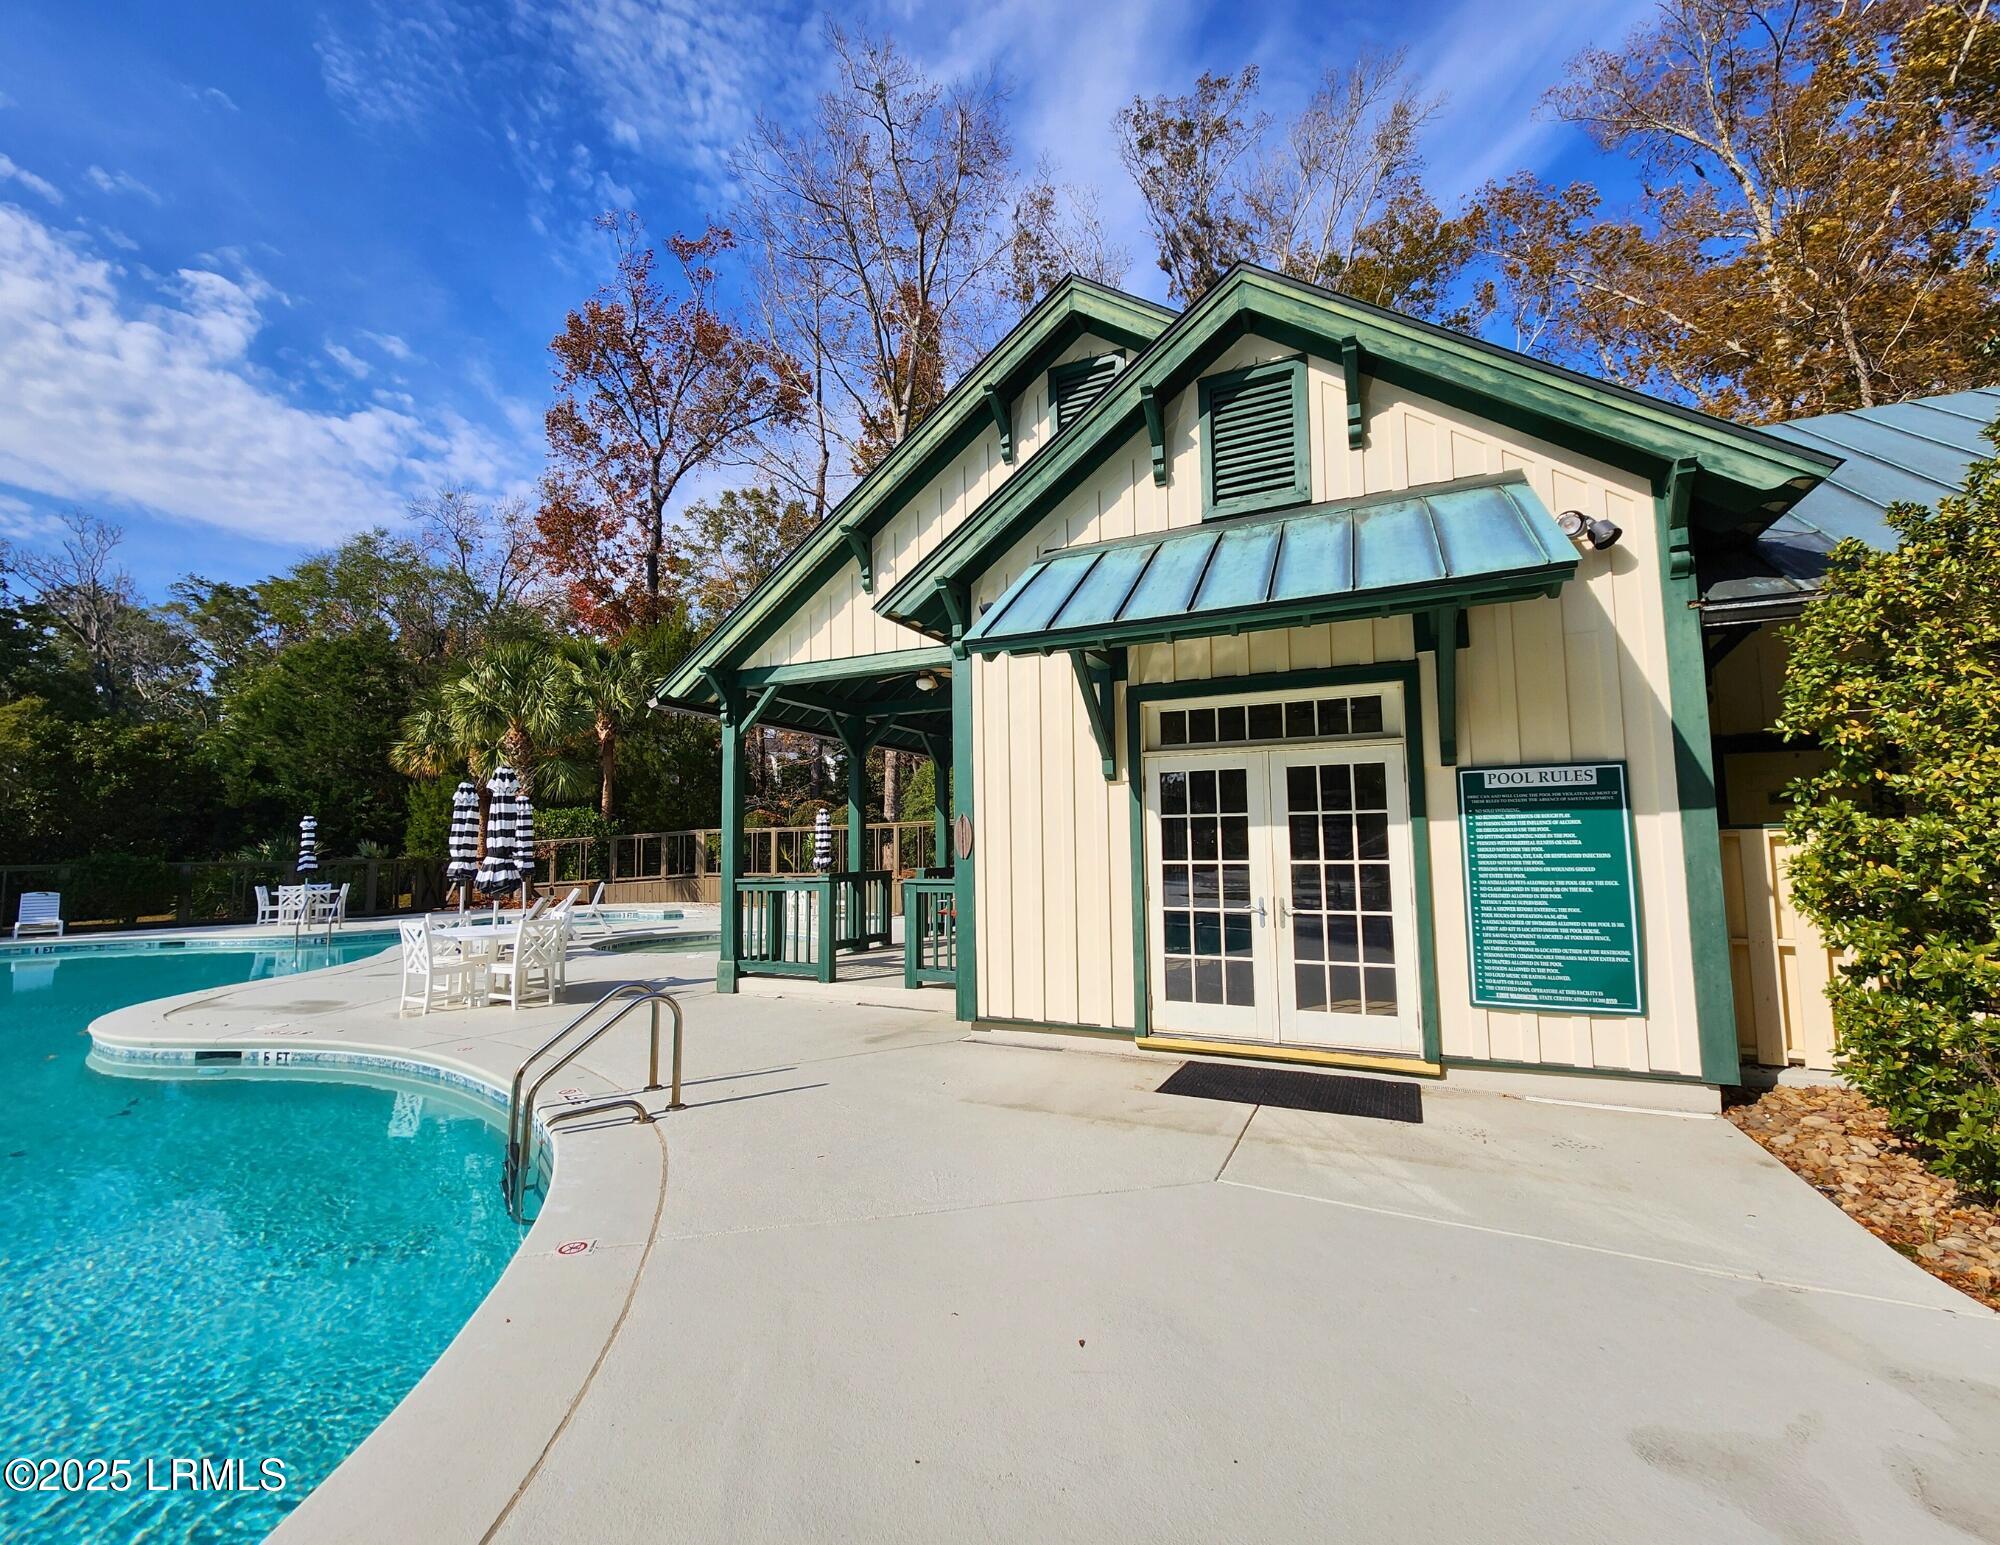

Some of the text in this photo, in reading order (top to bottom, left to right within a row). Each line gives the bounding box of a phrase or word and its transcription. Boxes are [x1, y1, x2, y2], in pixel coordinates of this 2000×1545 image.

[1487, 769, 1594, 785] POOL RULES
[276, 1052, 290, 1062] FT
